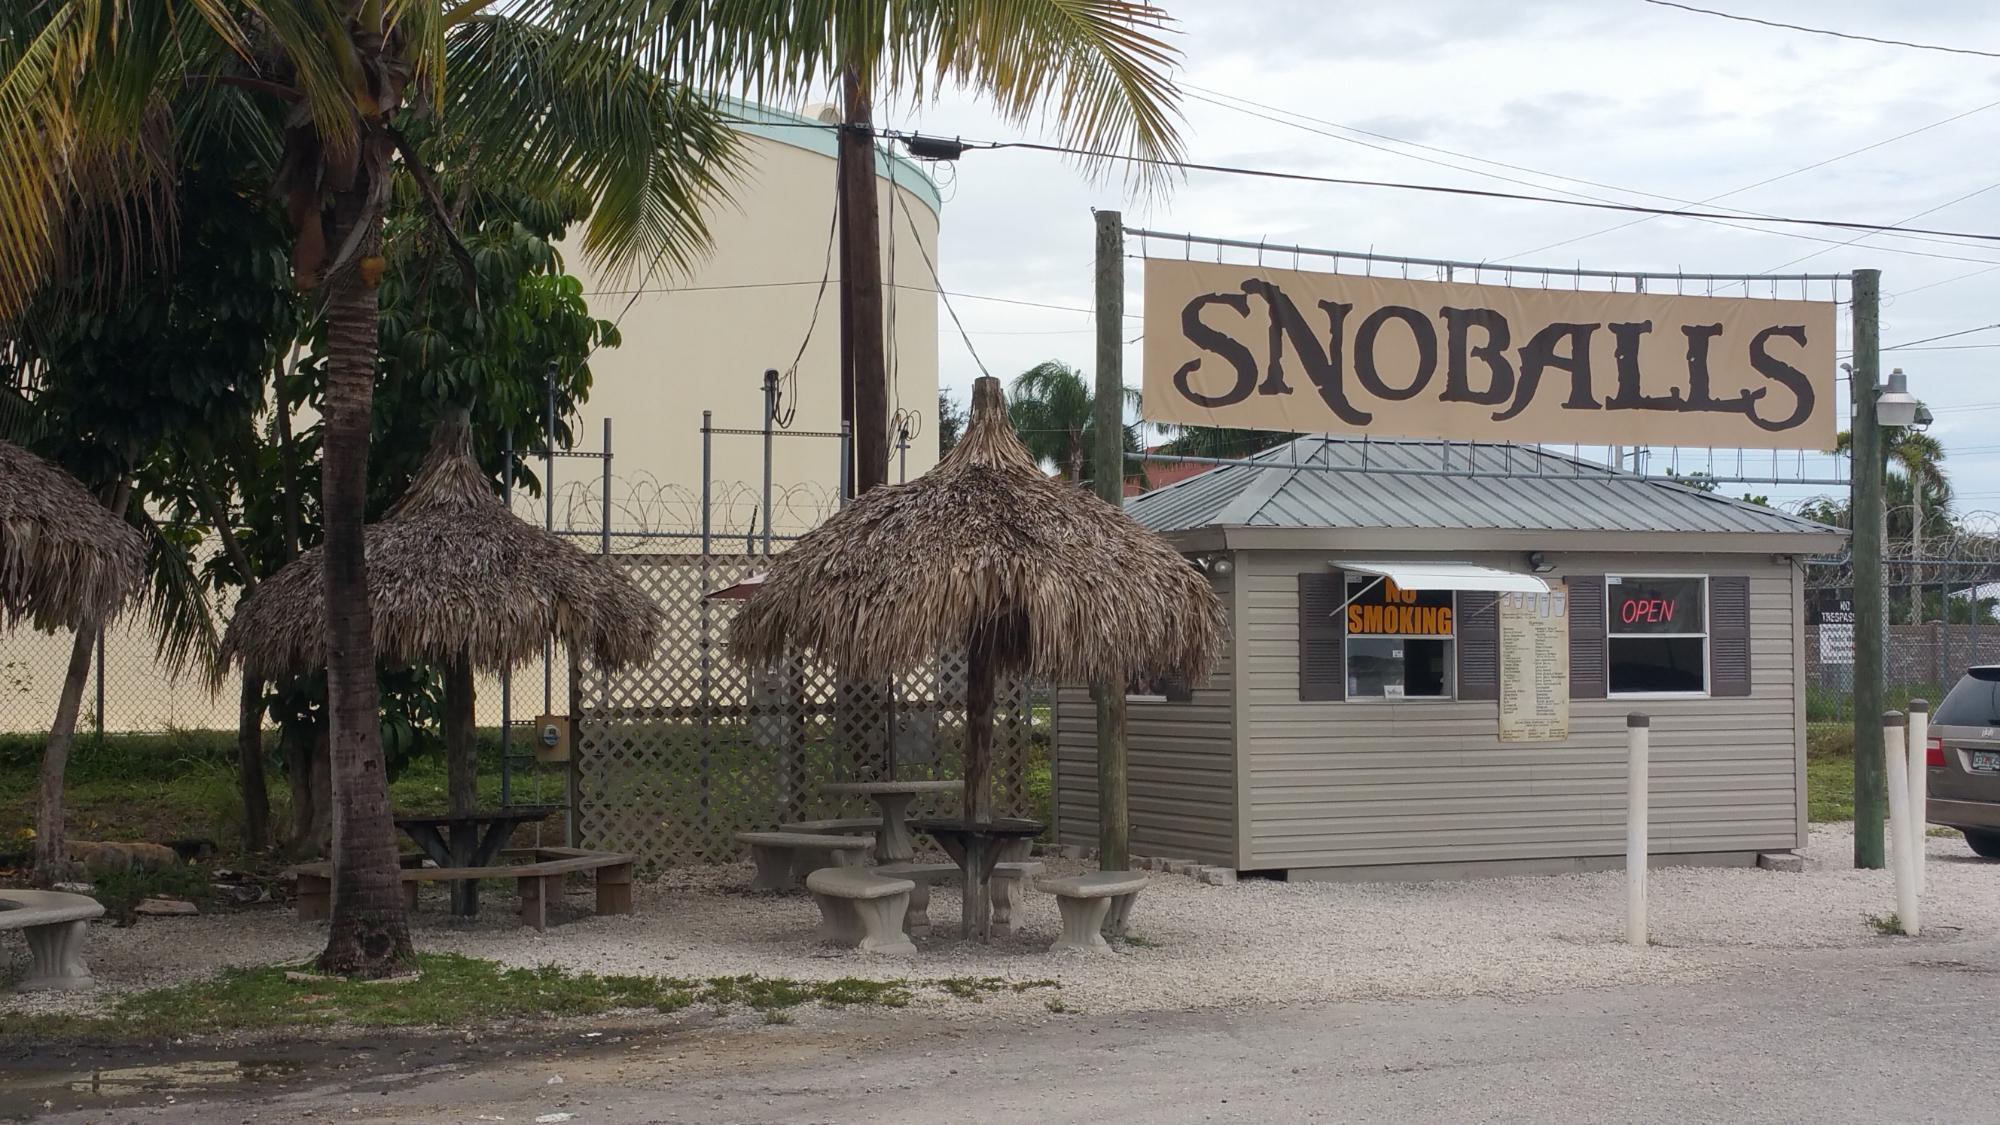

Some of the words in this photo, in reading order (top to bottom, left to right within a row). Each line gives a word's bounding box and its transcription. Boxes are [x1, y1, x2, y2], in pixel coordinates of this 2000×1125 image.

[1173, 277, 1815, 432] SNOBALLS
[1348, 604, 1452, 635] SMOKING
[1622, 600, 1675, 624] OPEN
[1821, 612, 1855, 622] TRESPAS
